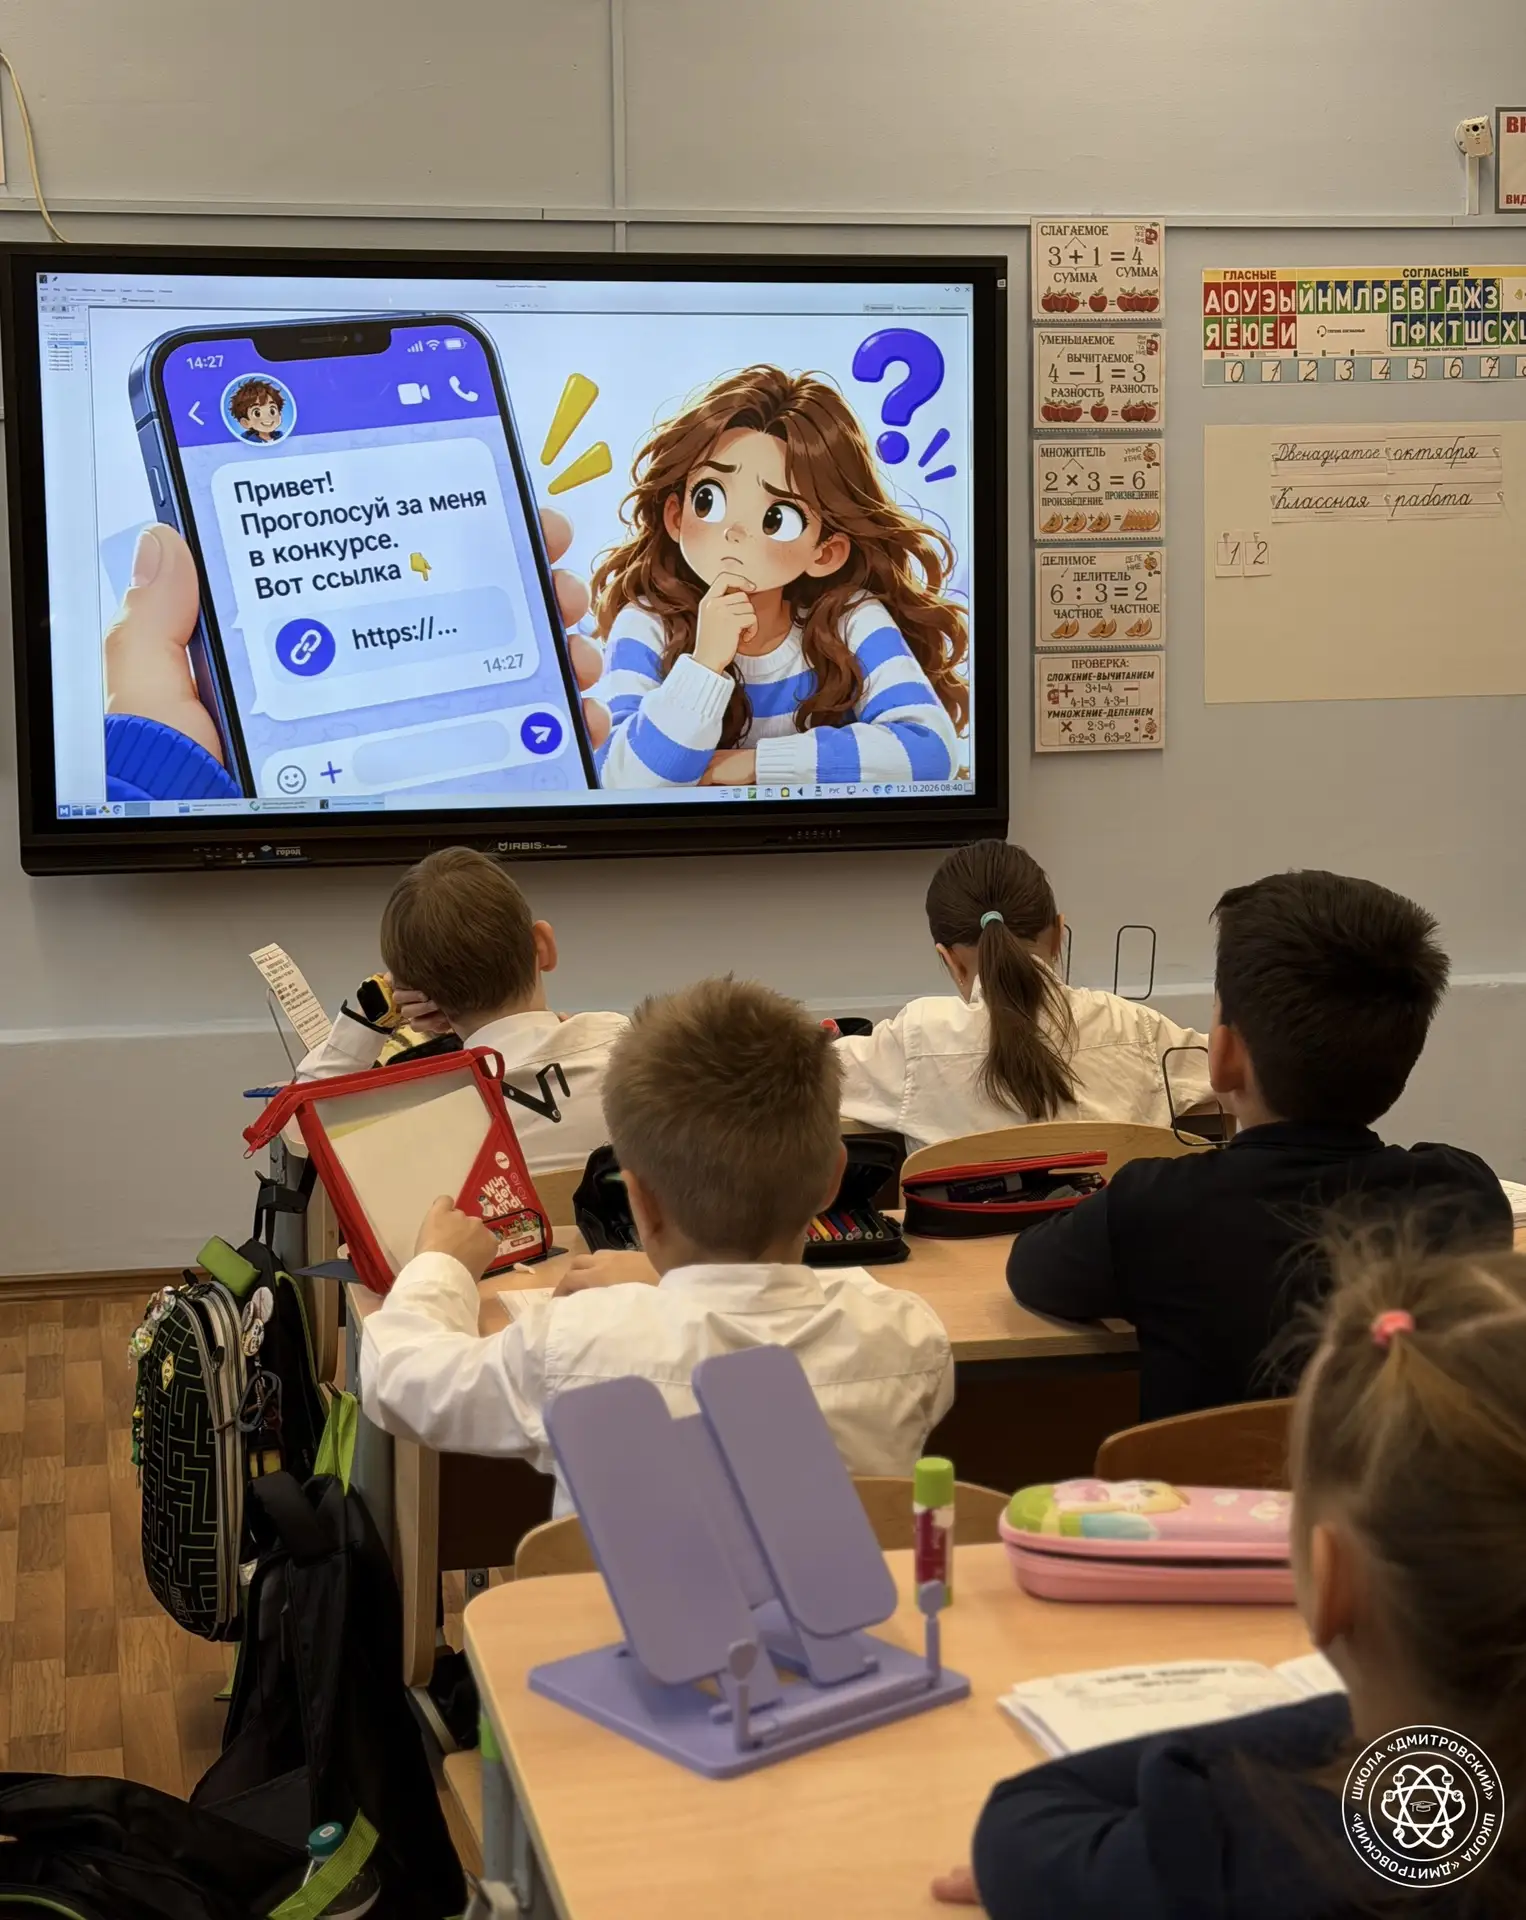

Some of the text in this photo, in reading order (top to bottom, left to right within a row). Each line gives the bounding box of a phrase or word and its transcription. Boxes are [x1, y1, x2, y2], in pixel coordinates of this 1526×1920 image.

[1040, 225, 1108, 236] СЛАГАЕМОЕ
[1048, 247, 1062, 267] 3
[1093, 247, 1103, 266] 1
[1131, 246, 1144, 265] 4
[1054, 272, 1098, 283] СУММА
[1116, 266, 1158, 278] СУММА
[1223, 270, 1277, 280] ГЛАСНЫЕ
[1402, 268, 1470, 278] СОГЛАСНЫЕ
[1040, 335, 1115, 345] УМЕНЬШАЕМОЕ
[186, 355, 224, 370] 14:27
[1066, 354, 1134, 363] ВЫЧИТАЕМОЕ
[1048, 363, 1059, 382] 4
[1094, 364, 1104, 383] 1
[1132, 364, 1146, 383] 3
[1230, 361, 1244, 382] 0
[1271, 360, 1282, 382] 1
[1304, 360, 1318, 381] 2
[1340, 360, 1354, 381] 3
[1378, 358, 1390, 380] 4
[1412, 358, 1426, 379] 5
[1450, 356, 1464, 378] 6
[1486, 356, 1500, 378] 7
[1051, 388, 1104, 398] РАЗНОСТЬ
[1110, 384, 1158, 394] РАЗНОСТЬ
[1040, 447, 1106, 458] МНОЖИТЕЛЬ
[1274, 436, 1478, 468] Двенадцатое октября
[1045, 472, 1058, 490] 2
[1088, 472, 1100, 492] 3
[1132, 470, 1146, 490] 6
[234, 471, 334, 507] Привет!
[1042, 497, 1104, 506] ПРОИЗВЕДЕНИЕ
[1275, 483, 1472, 517] Классная работа
[240, 490, 487, 538] Проголосуй за меня
[249, 532, 399, 567] в конкурсе.
[1230, 541, 1268, 566] 1 2
[1042, 556, 1096, 566] ДЕЛИМОЕ
[255, 562, 402, 600] Вот ссылка
[1073, 572, 1131, 582] ДЕЛИТЕЛЬ
[1050, 584, 1064, 603] 6
[1095, 583, 1108, 602] 3
[1135, 582, 1148, 600] 2
[1054, 608, 1103, 618] ЧАСТНОЕ
[1110, 604, 1160, 614] ЧАСТНОЕ
[482, 654, 524, 674] 14:27
[1072, 659, 1130, 669] ПРОВЕРКА:
[1085, 684, 1113, 694] 3+1=4
[1070, 696, 1129, 707] 4-1=3 4-3=1
[1068, 732, 1131, 744] 6:2=3 6:3=2
[896, 784, 940, 793] 12.10.2026
[940, 784, 963, 792] 08:40
[508, 842, 542, 850] IRBIS
[481, 1176, 508, 1198] wun
